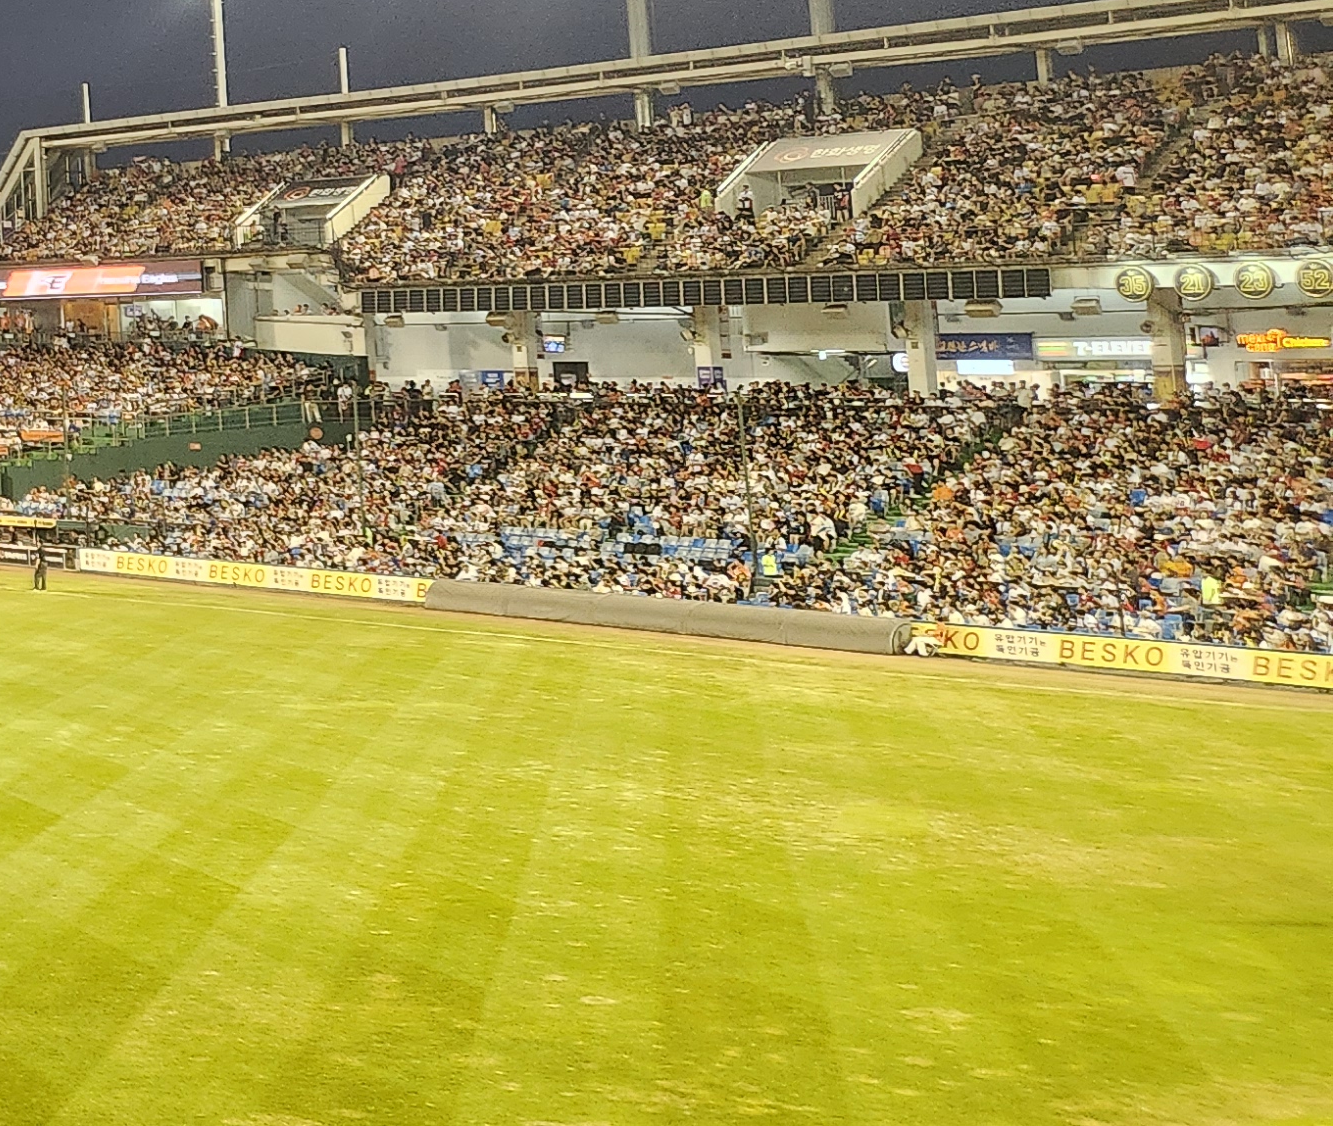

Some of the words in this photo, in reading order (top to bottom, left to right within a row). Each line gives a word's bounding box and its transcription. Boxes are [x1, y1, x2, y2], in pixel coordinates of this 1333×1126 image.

[809, 143, 881, 159] 한화생명
[1119, 276, 1147, 296] 35
[1180, 273, 1204, 294] 21
[1239, 271, 1268, 292] 23
[1300, 269, 1330, 291] 52
[116, 555, 168, 574] BESKO
[209, 564, 265, 583] BESKO
[311, 573, 372, 593] BESKO
[1059, 639, 1164, 667] BESKO
